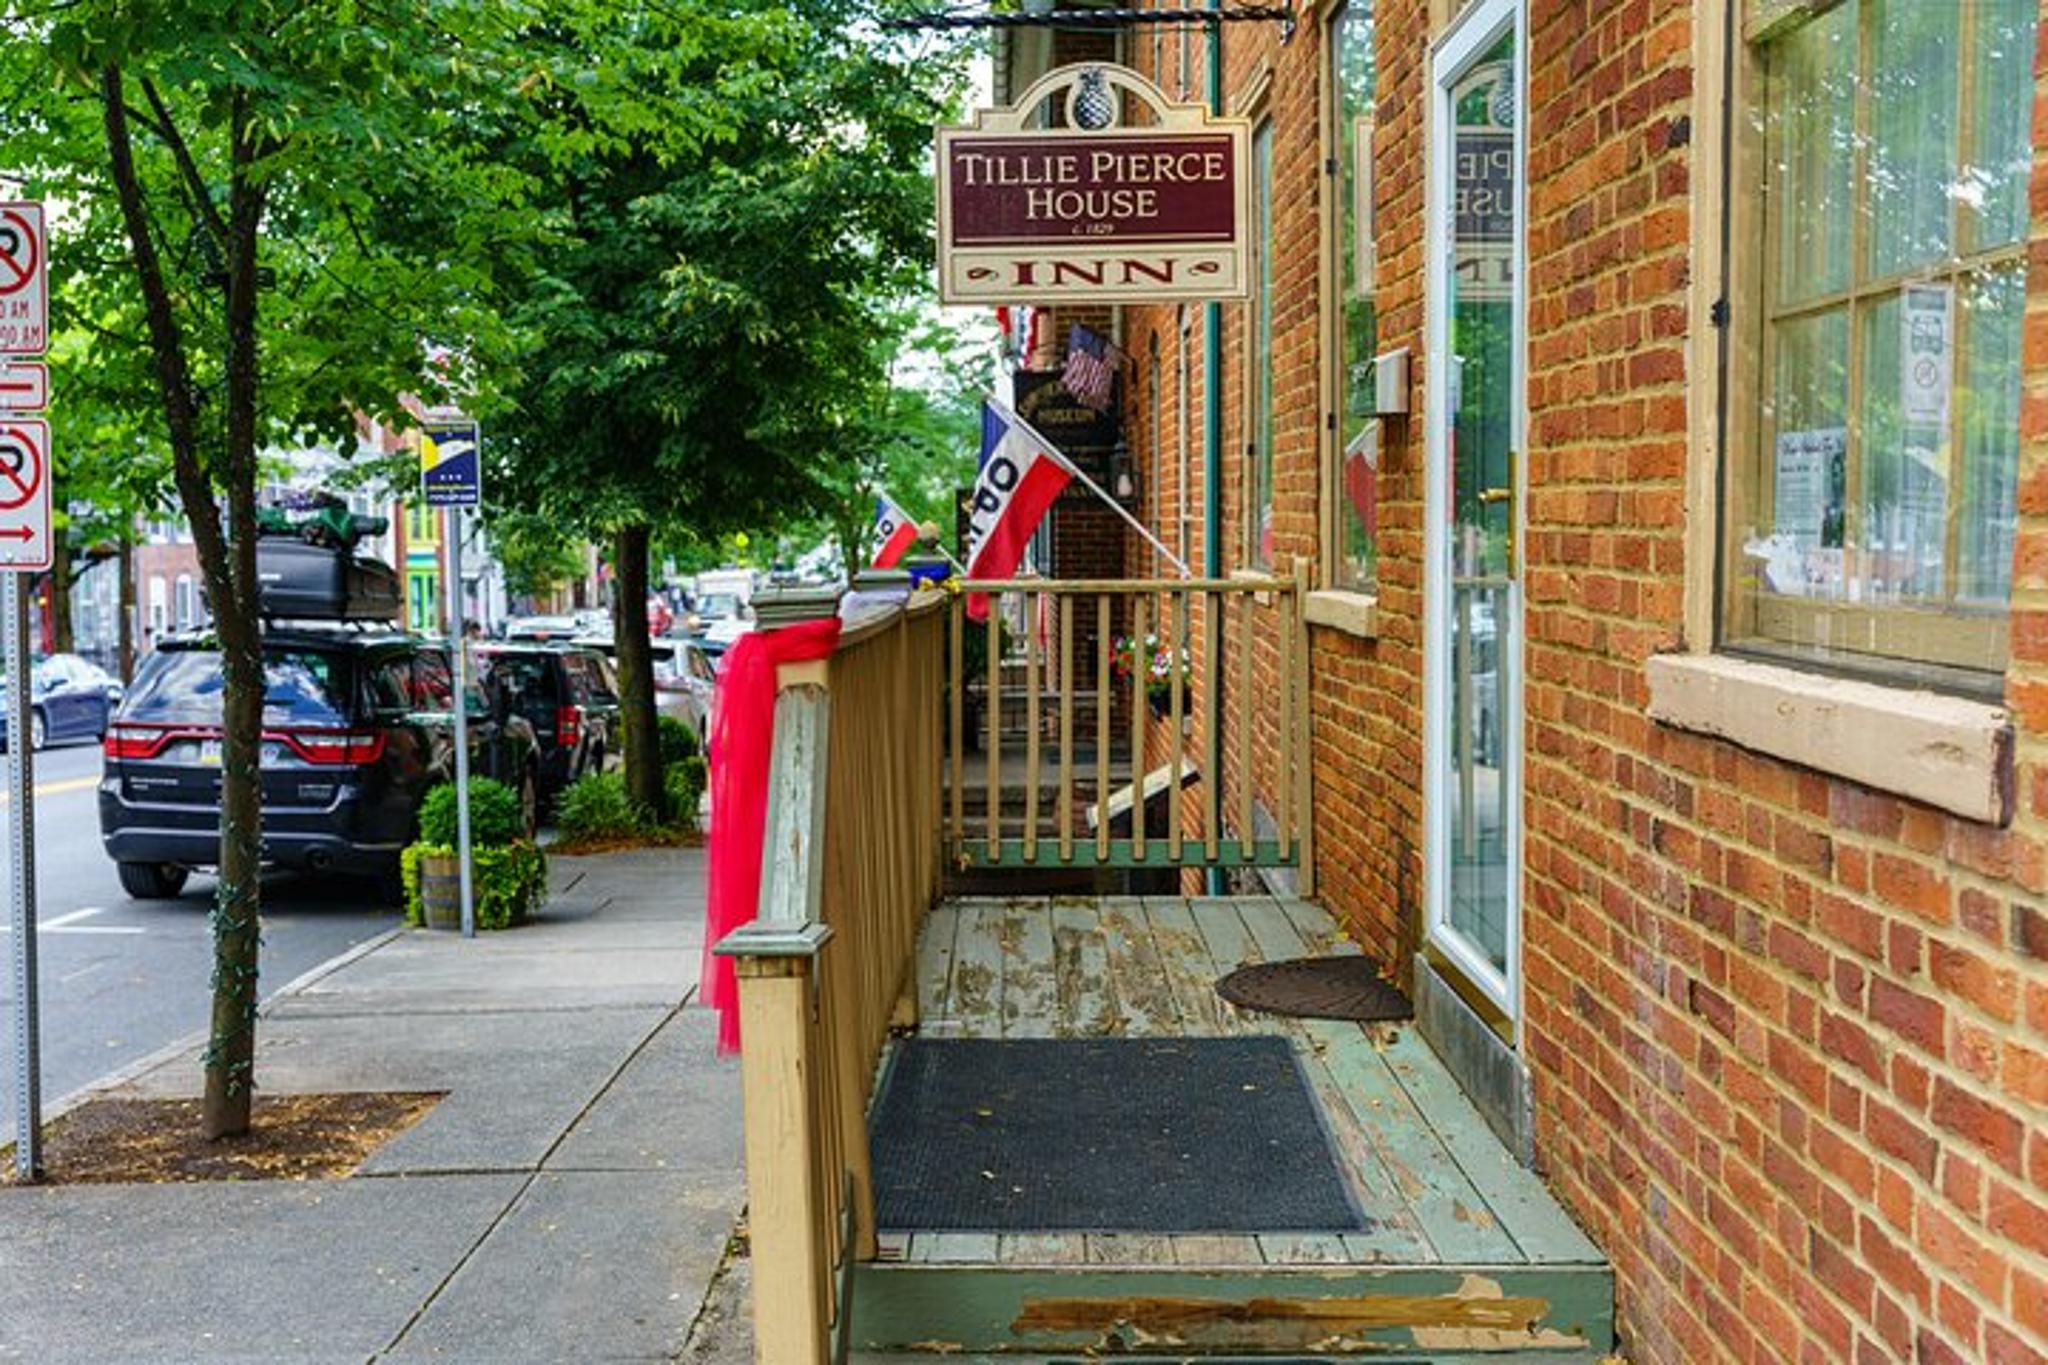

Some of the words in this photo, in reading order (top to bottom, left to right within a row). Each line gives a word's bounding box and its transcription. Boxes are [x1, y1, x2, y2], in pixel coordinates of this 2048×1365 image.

[956, 152, 1080, 186] TILLIE
[1090, 150, 1227, 183] PIERCE
[1025, 187, 1160, 219] HOUSE
[1012, 258, 1178, 286] INN
[11, 300, 29, 318] AM
[23, 325, 41, 344] AM
